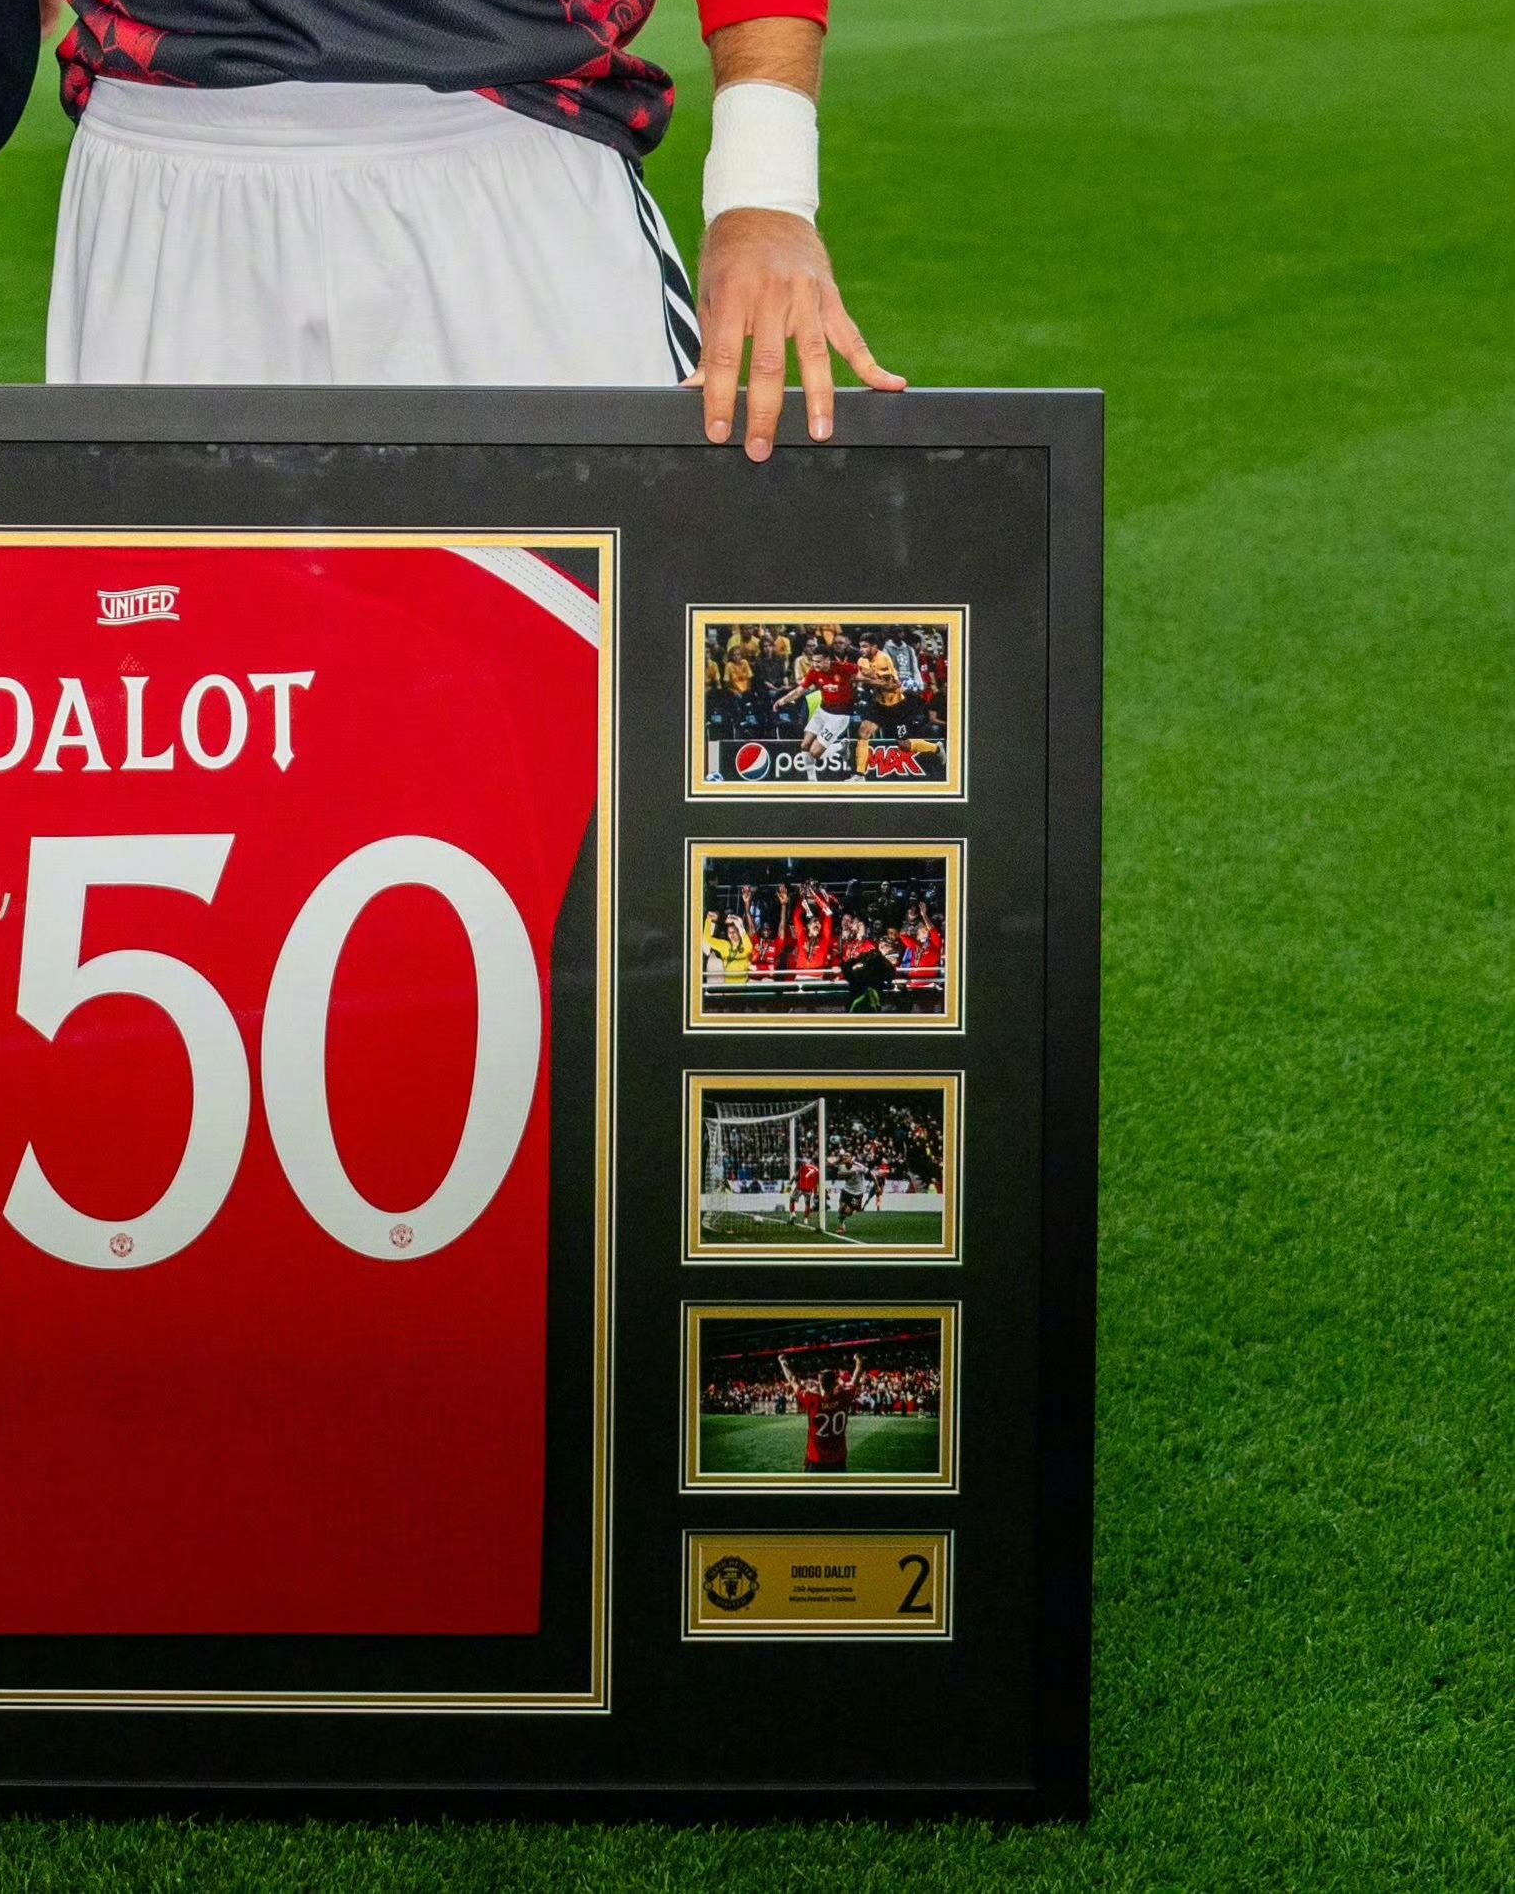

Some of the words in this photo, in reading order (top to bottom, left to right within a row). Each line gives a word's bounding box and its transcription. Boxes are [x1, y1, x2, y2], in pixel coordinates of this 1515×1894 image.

[100, 591, 175, 619] UNITED
[815, 1411, 846, 1437] 20
[791, 1565, 822, 1579] DIOGO
[824, 1565, 858, 1579] DALOT
[897, 1553, 934, 1614] 2
